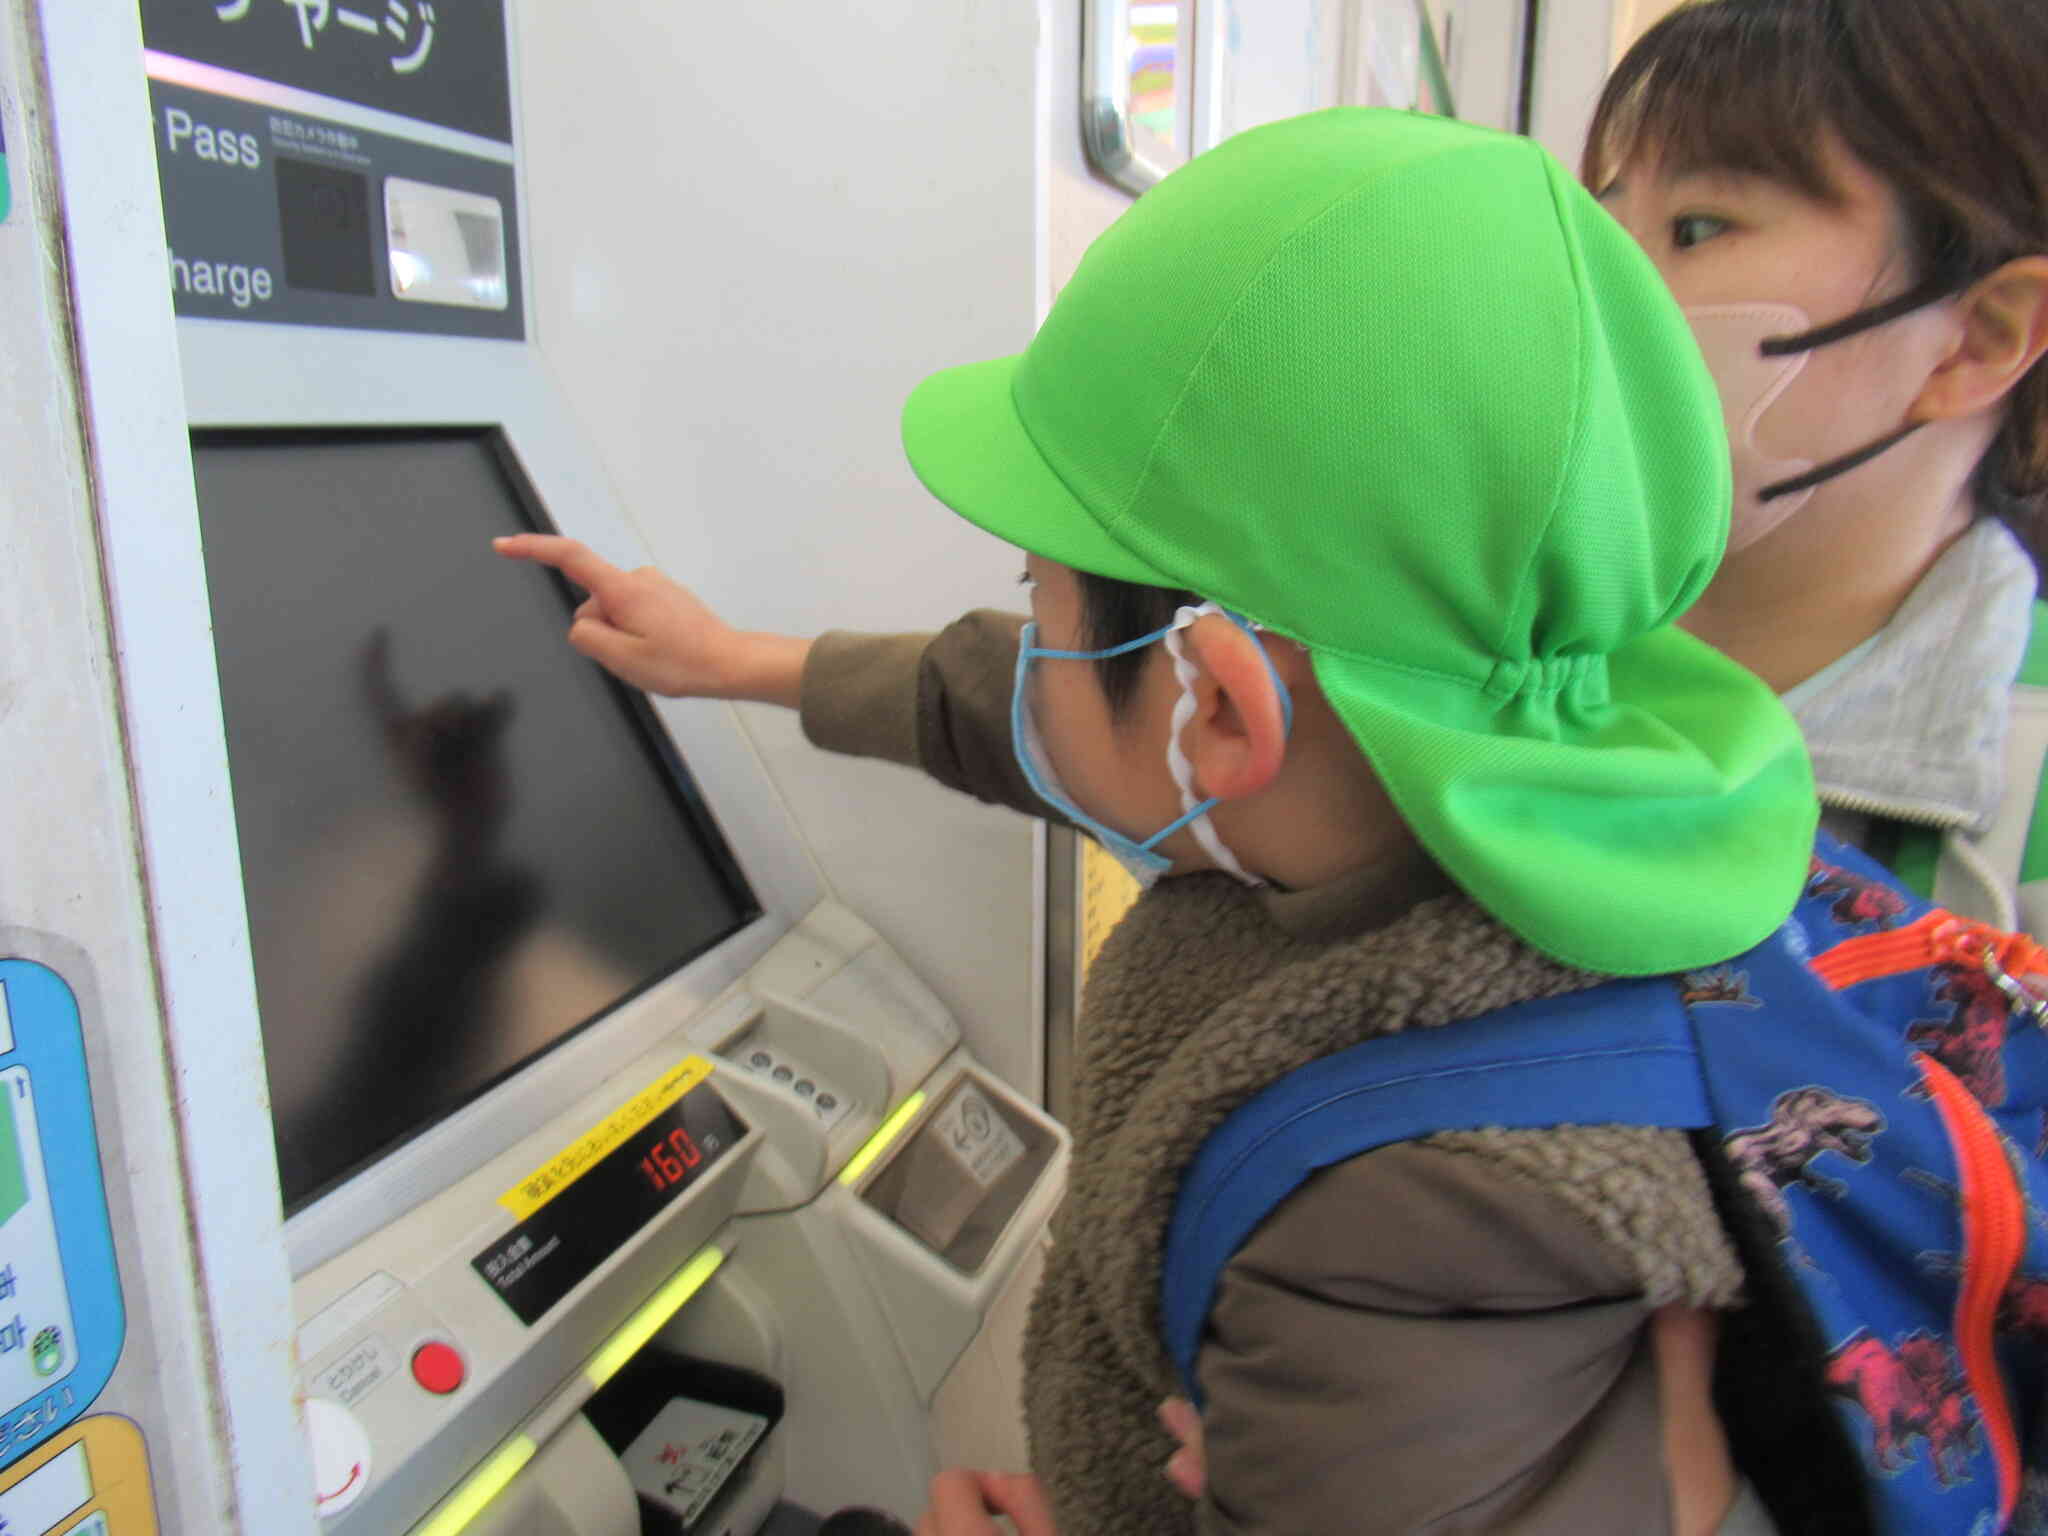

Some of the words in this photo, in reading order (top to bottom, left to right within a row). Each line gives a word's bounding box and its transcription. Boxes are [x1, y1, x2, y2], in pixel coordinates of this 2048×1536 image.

[216, 0, 436, 74] ャージ
[165, 106, 260, 168] Pass
[167, 248, 272, 308] harge
[640, 1127, 702, 1191] 160
